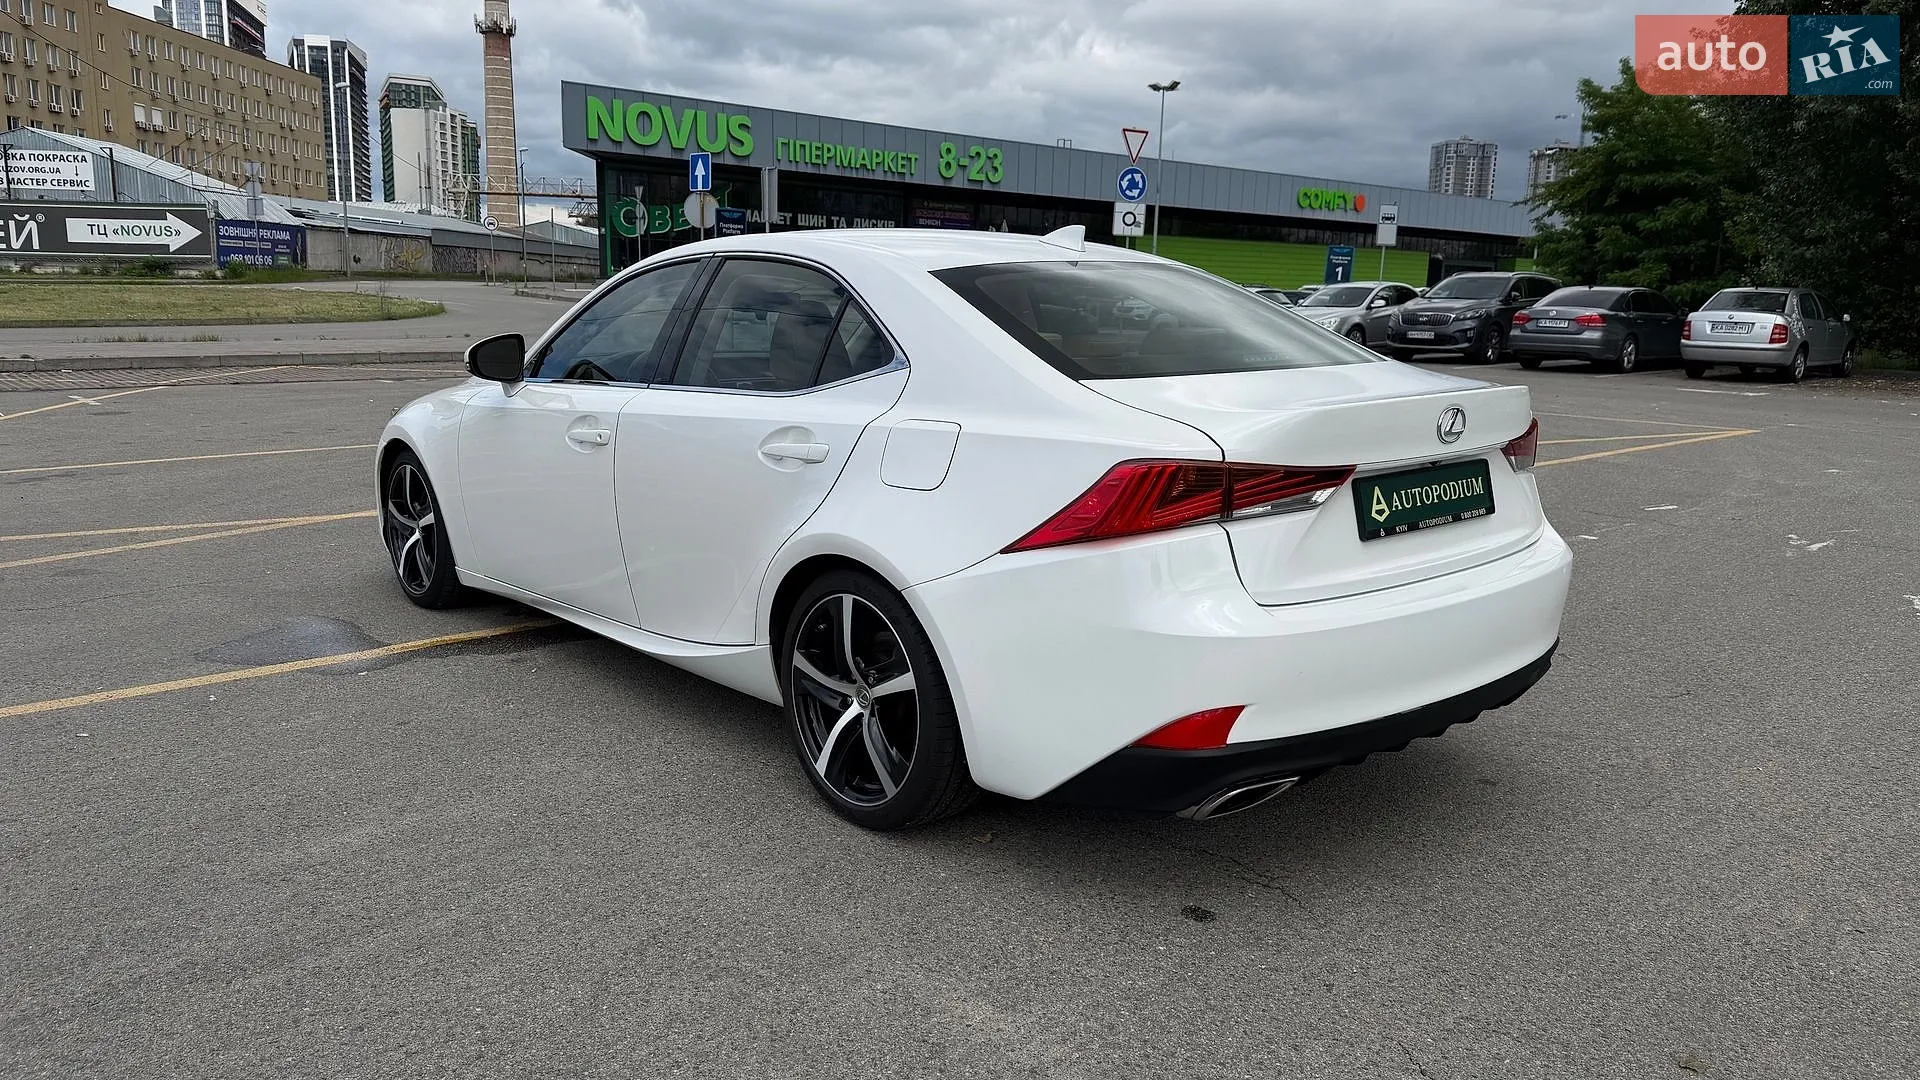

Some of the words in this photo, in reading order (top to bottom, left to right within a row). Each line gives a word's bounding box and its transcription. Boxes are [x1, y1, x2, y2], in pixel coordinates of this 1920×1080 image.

[586, 95, 755, 157] NOVUS
[29, 153, 88, 163] ПОКРАСКА
[776, 137, 919, 175] ГІПЕРМАРКЕТ
[938, 141, 1004, 184] 8-23
[8, 177, 48, 186] МАСТЕР
[50, 179, 90, 188] СЕРВИС
[1297, 188, 1354, 211] COMFY
[797, 214, 827, 228] ШИН
[831, 216, 847, 228] ТА
[87, 223, 108, 238] ТЦ
[259, 229, 291, 241] РЕКЛАМА
[1335, 266, 1343, 281] 1
[1391, 476, 1485, 512] AUTOPODIUM
[1395, 524, 1409, 533] KYIV
[1418, 515, 1454, 529] AUTOPODIUM
